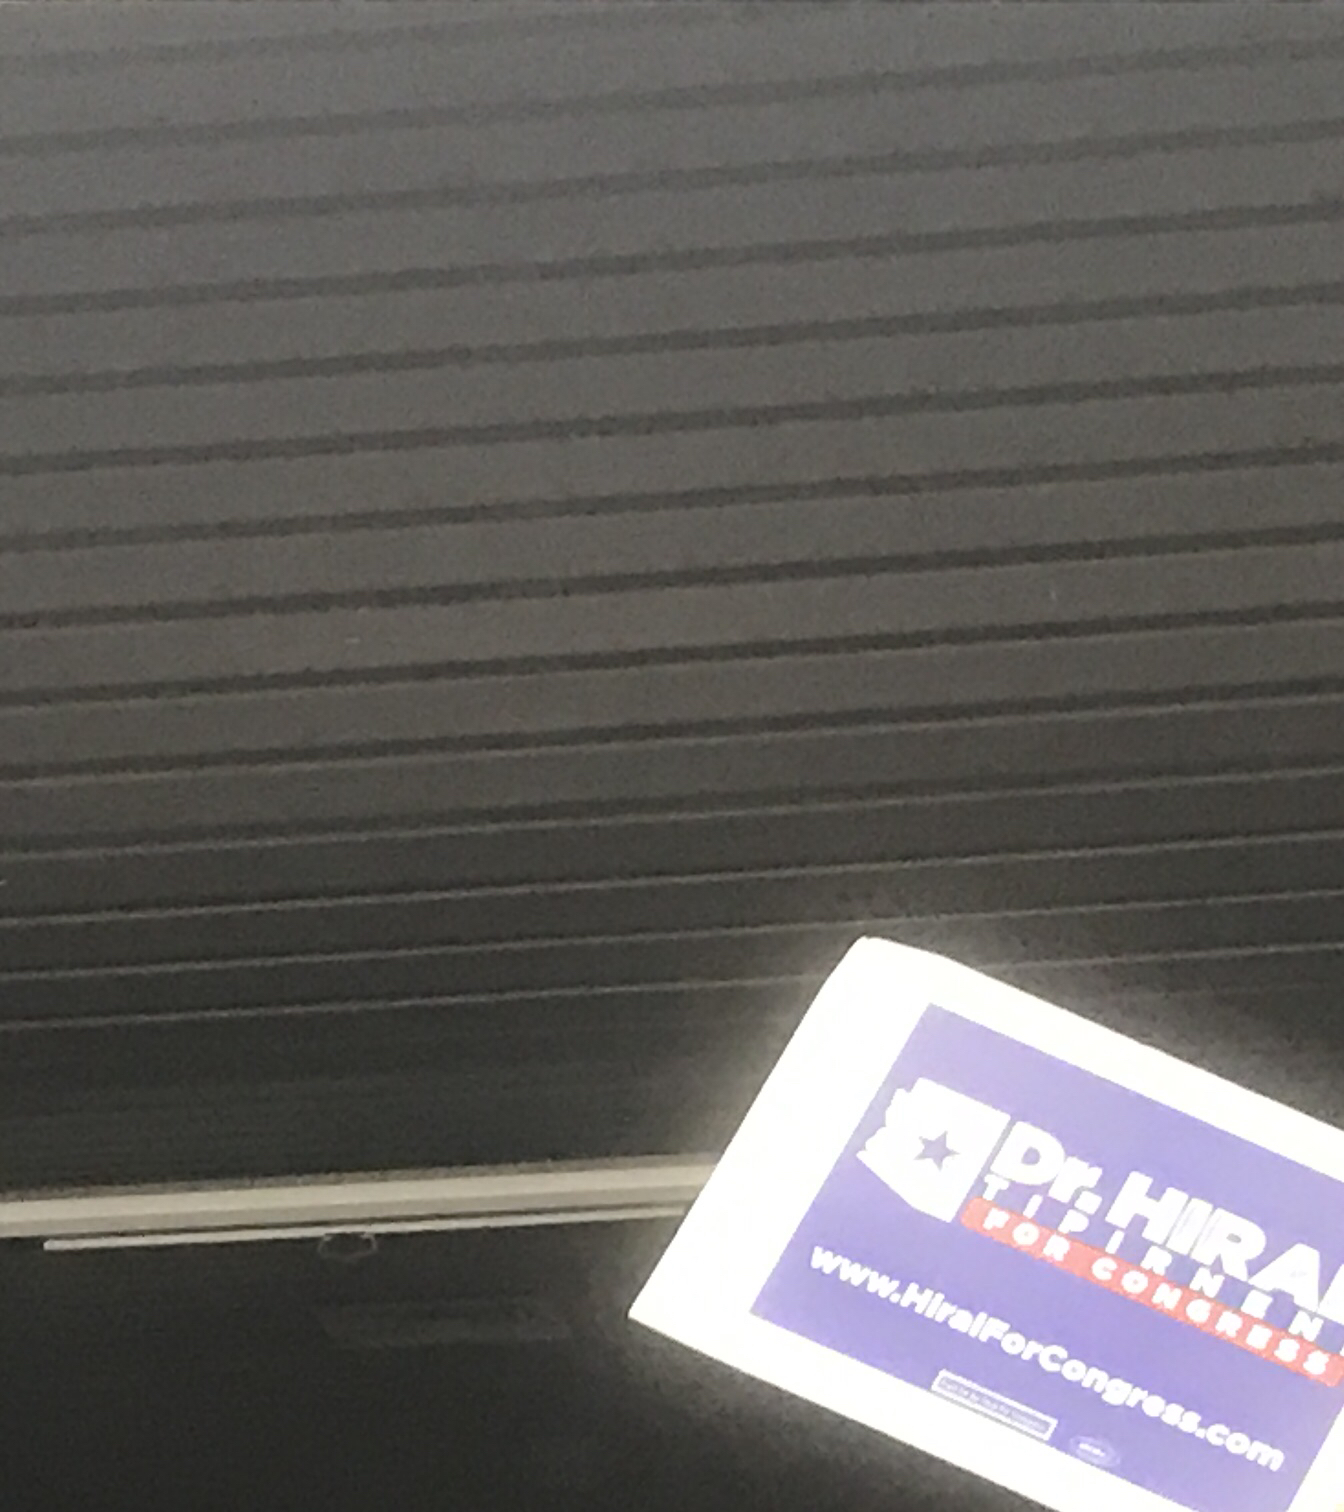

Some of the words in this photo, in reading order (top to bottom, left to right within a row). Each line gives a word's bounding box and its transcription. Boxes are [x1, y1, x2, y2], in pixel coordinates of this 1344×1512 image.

[990, 1121, 1103, 1214] Dr.
[810, 1246, 1286, 1472] www.HiralForCongress.com
[983, 1206, 1072, 1261] FOR
[1091, 1256, 1332, 1377] CONGRESS
